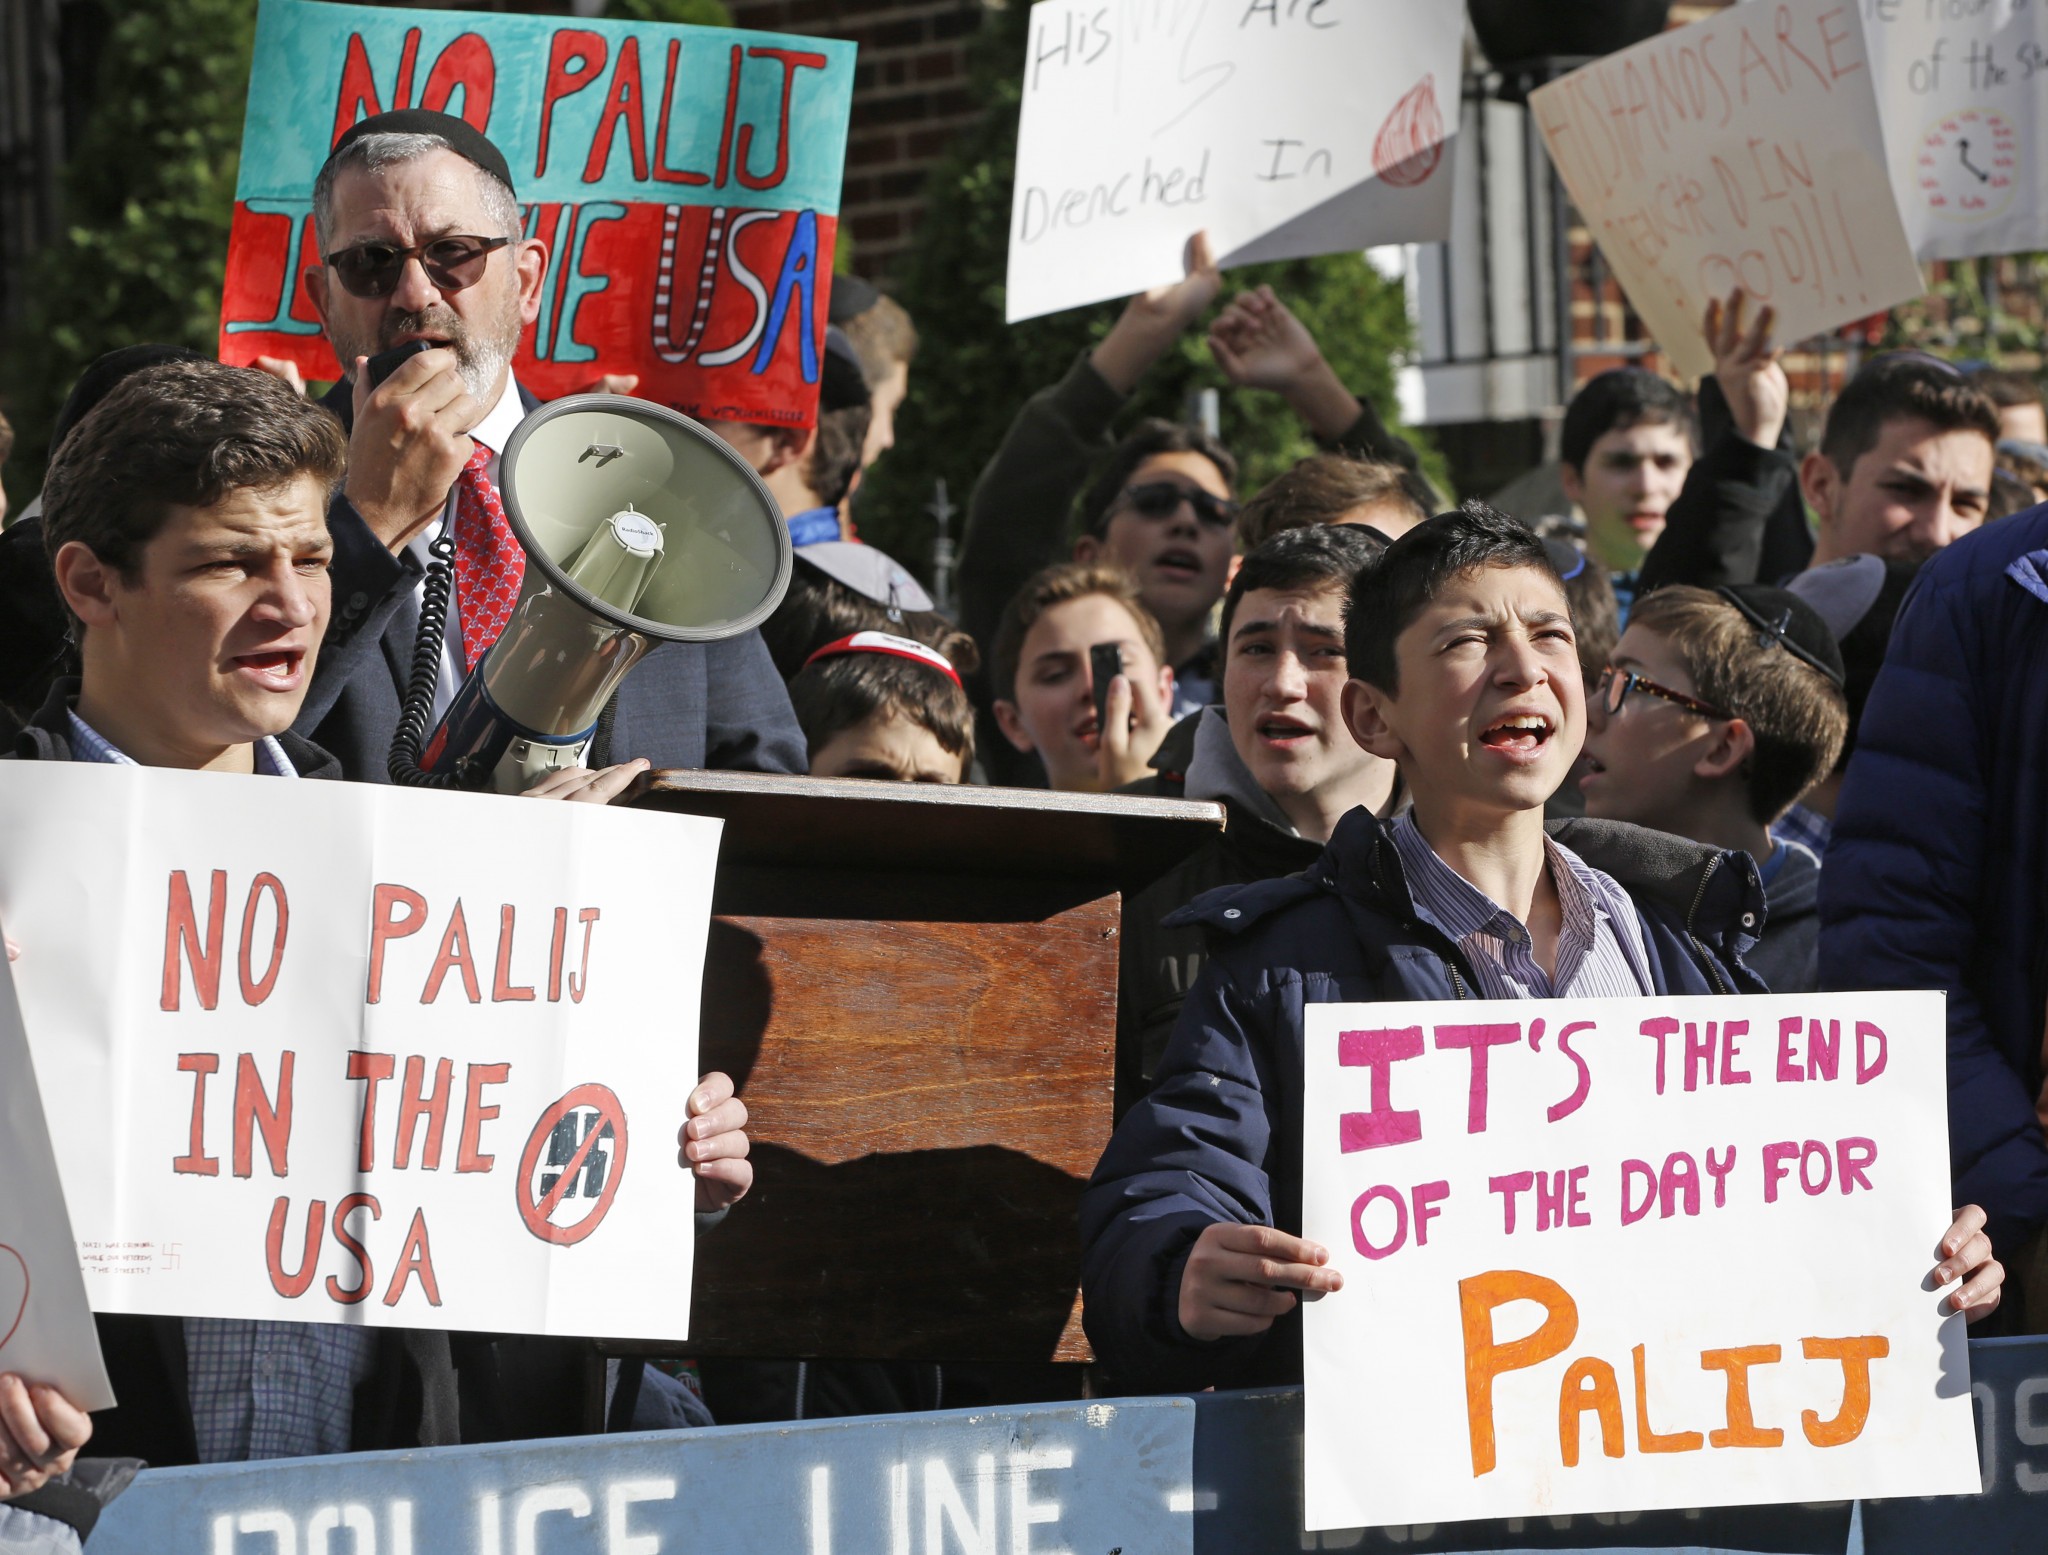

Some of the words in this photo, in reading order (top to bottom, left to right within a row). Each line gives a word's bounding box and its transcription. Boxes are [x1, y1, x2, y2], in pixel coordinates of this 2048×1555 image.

[535, 29, 827, 190] PALIJ
[1032, 9, 1111, 91] His
[1908, 36, 1950, 96] of
[1021, 148, 1210, 244] Drenched
[1256, 138, 1332, 181] In
[519, 201, 628, 363] HE
[652, 203, 819, 384] USA
[160, 869, 290, 1012] NO
[365, 883, 600, 1005] PALIJ
[173, 1051, 296, 1180] IN
[346, 1051, 512, 1174] THE
[1338, 1017, 1597, 1154] IT'S
[1639, 1016, 1751, 1095] THE
[1776, 1016, 1889, 1084] END
[265, 1193, 443, 1308] USA
[1350, 1180, 1451, 1261] OF
[1488, 1165, 1592, 1234] THE
[1620, 1144, 1737, 1226] DAY
[1762, 1137, 1878, 1204] FOR
